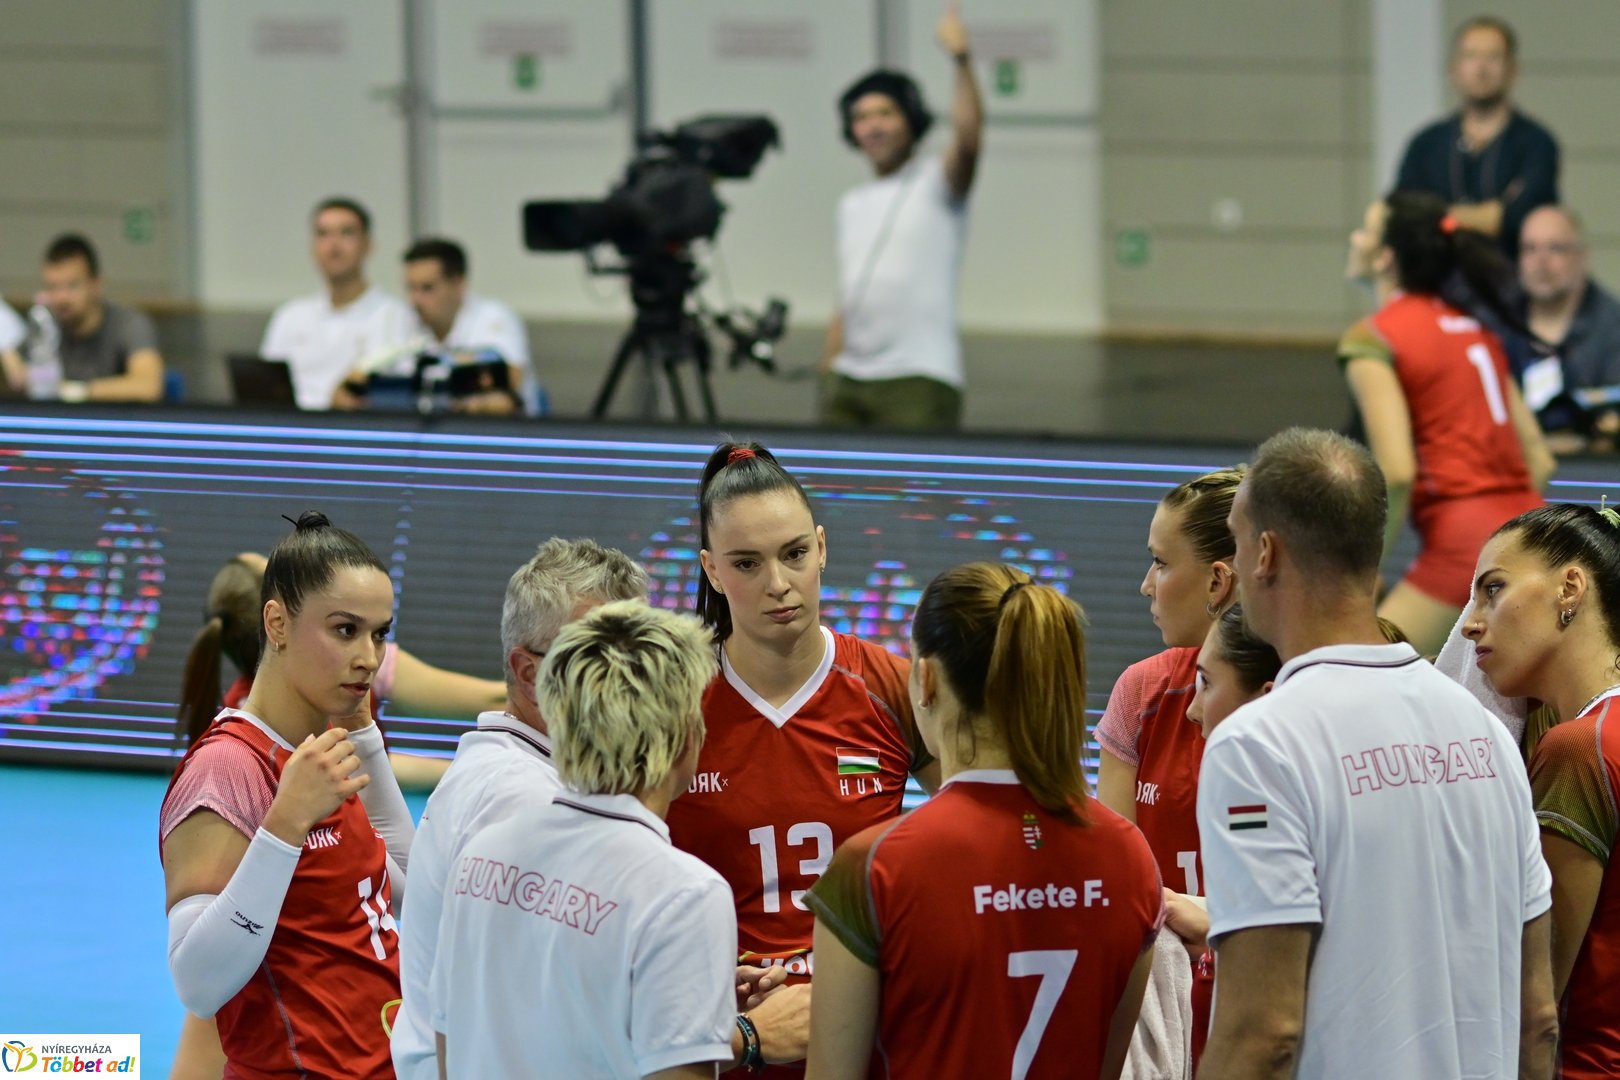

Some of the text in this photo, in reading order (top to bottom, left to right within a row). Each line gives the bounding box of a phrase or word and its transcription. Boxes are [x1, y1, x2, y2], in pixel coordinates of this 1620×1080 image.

[839, 777, 883, 796] HUN
[1341, 737, 1496, 796] HUNGAR
[455, 857, 618, 935] HUNGARY
[748, 821, 834, 913] 13
[973, 879, 1109, 914] Fekete F.
[1007, 949, 1078, 1080] 7
